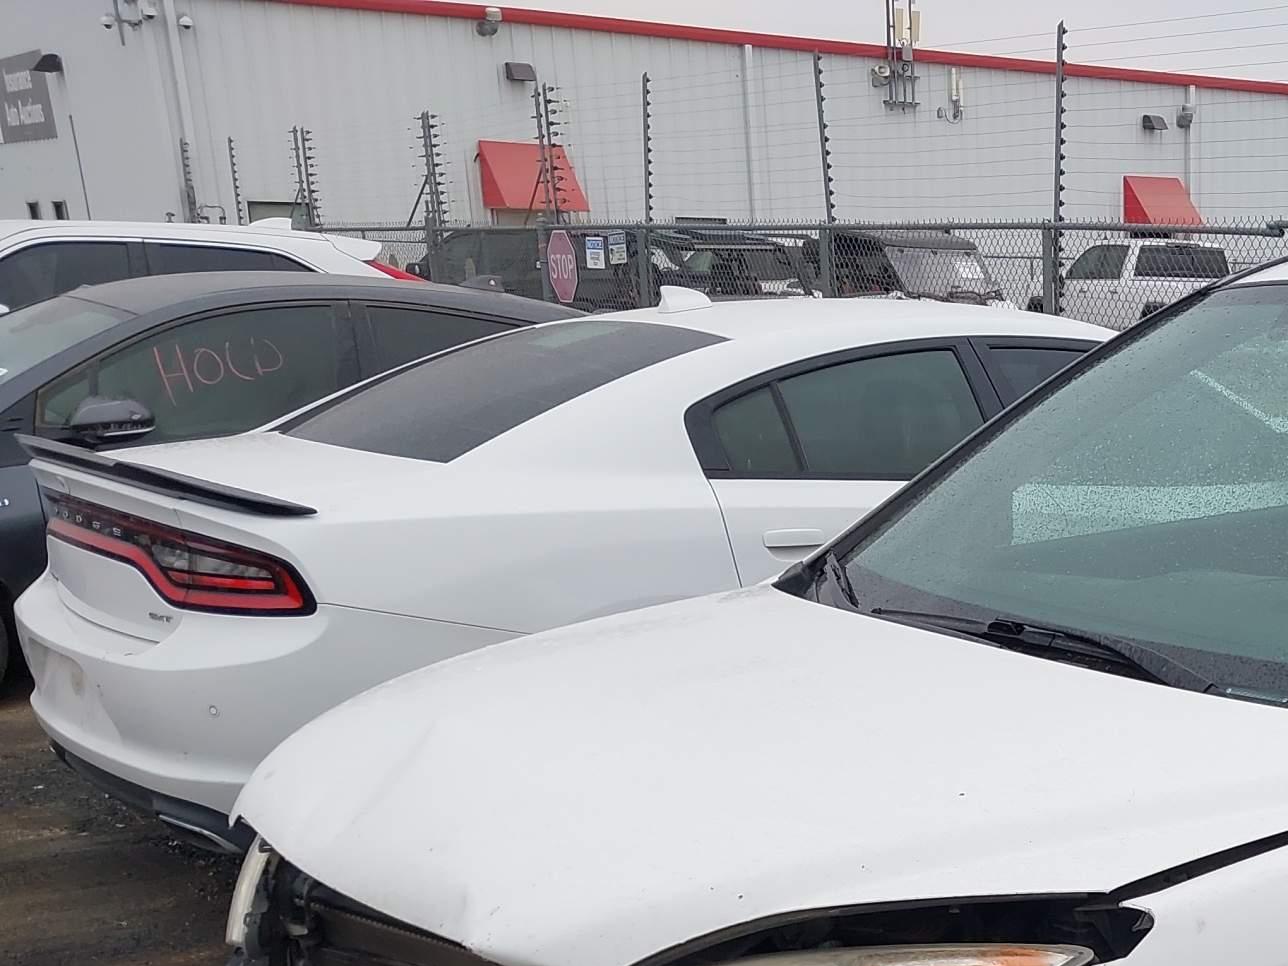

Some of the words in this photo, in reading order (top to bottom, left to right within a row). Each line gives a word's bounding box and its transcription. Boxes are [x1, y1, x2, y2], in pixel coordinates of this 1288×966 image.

[3, 69, 33, 93] Insurance
[4, 101, 20, 126] Auto
[18, 97, 46, 125] Auctions
[550, 254, 574, 280] STOP
[153, 336, 283, 407] HOLD
